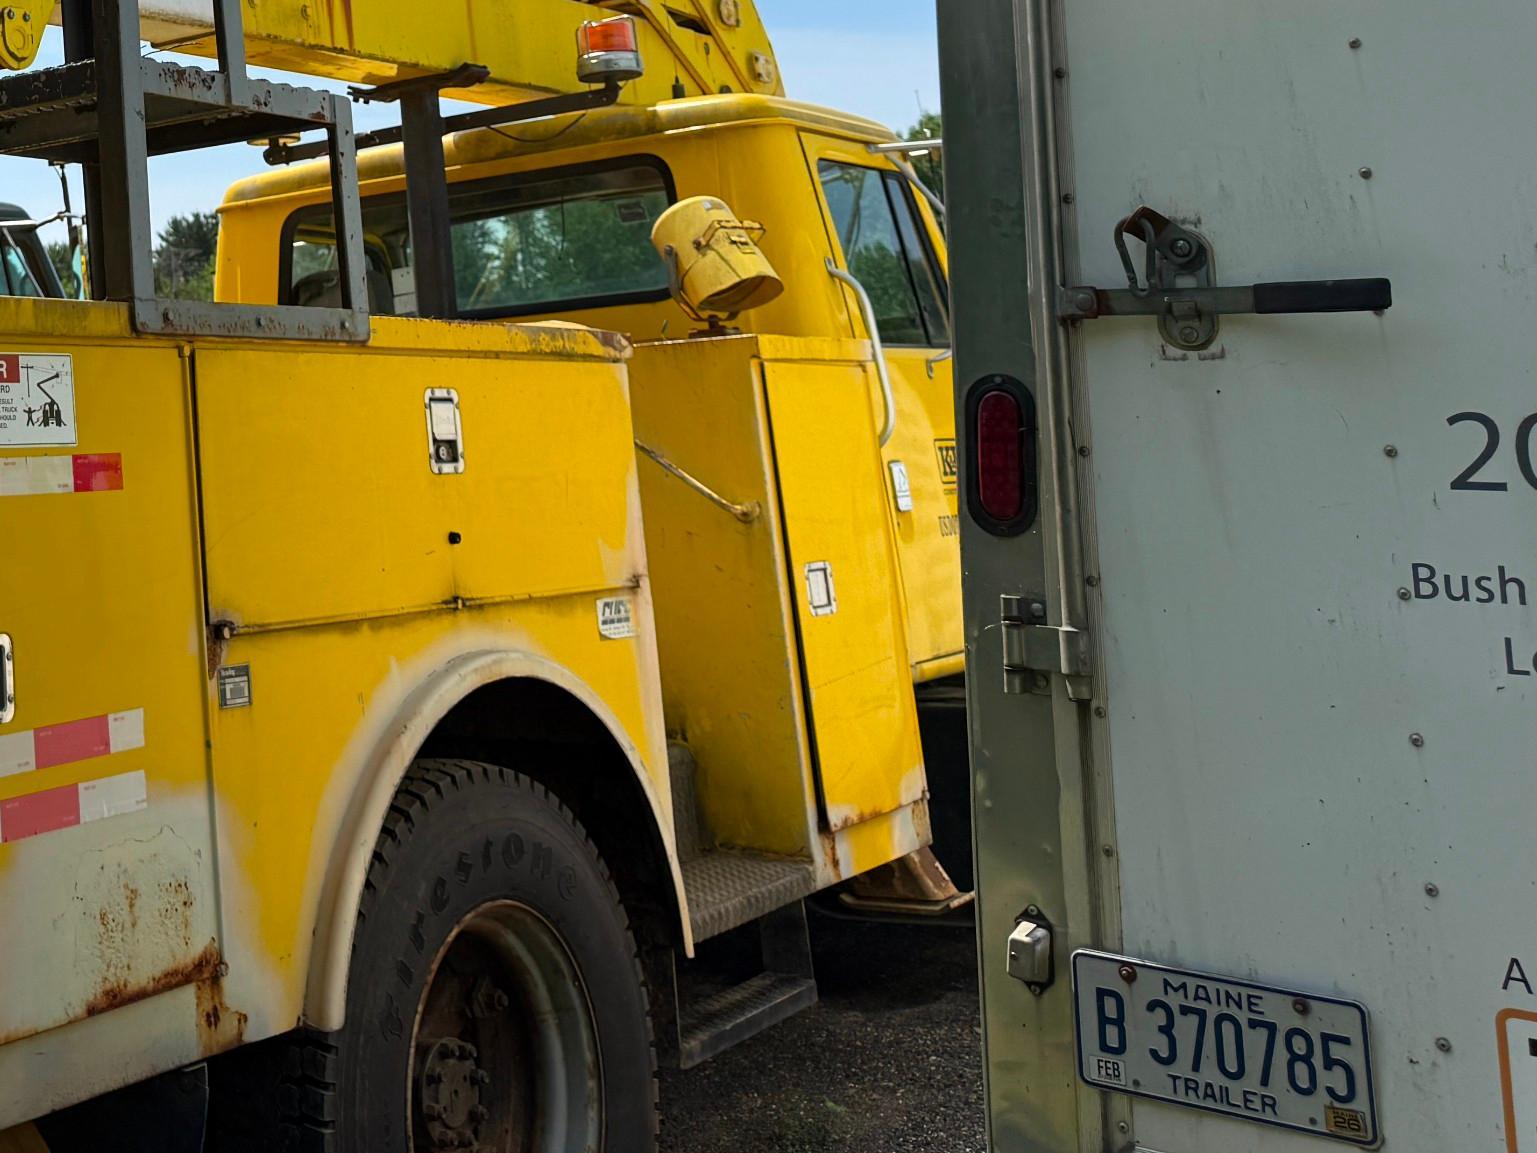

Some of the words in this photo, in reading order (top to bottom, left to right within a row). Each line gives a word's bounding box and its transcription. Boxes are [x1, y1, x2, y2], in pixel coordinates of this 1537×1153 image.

[1411, 562, 1527, 606] Bush
[1504, 636, 1537, 677] L
[1501, 957, 1534, 995] A
[1162, 978, 1264, 1015] MAINE
[1095, 986, 1127, 1055] B
[1146, 999, 1356, 1104] 370785
[1097, 1058, 1121, 1078] FEB
[1167, 1073, 1278, 1116] TRAILER
[1333, 1116, 1361, 1133] 26
